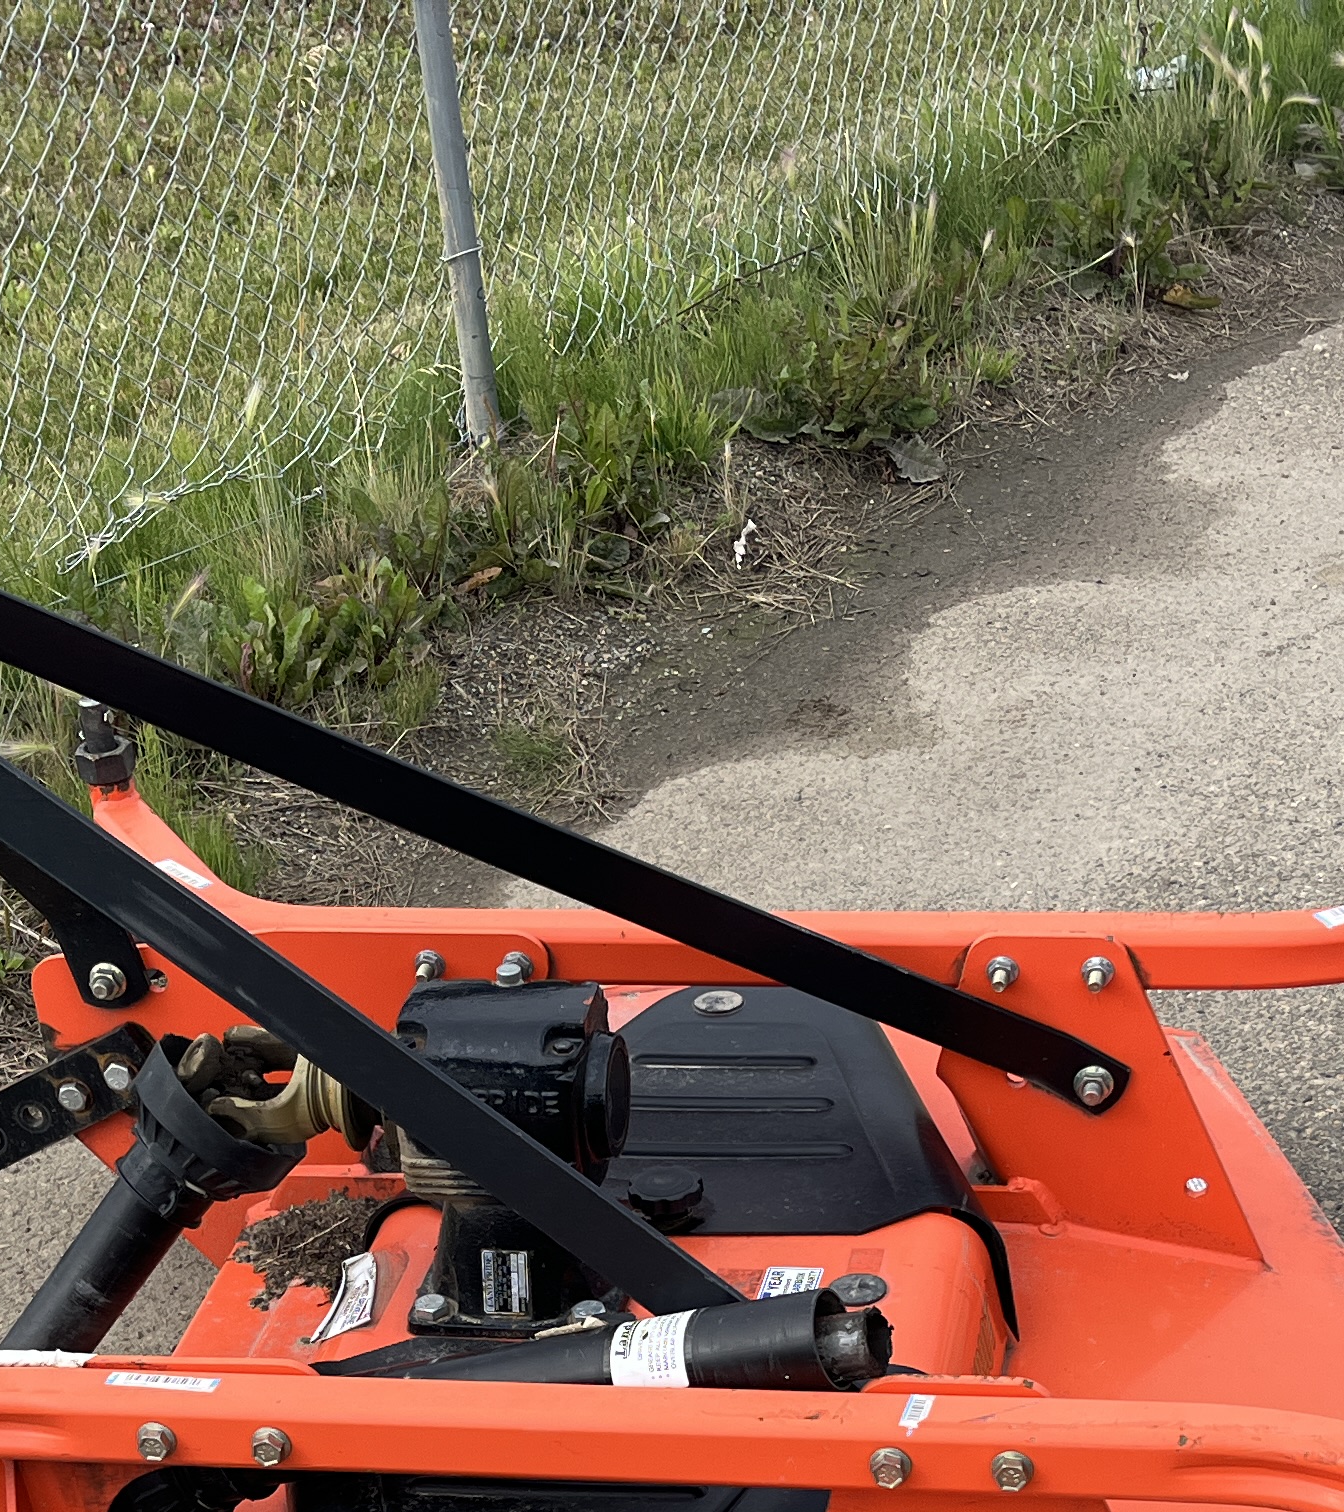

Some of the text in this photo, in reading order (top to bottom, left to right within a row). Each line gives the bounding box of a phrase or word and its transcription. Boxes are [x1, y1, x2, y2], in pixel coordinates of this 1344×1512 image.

[767, 1270, 785, 1290] YEAR
[485, 1283, 494, 1308] LAND
[615, 1324, 632, 1359] Land
